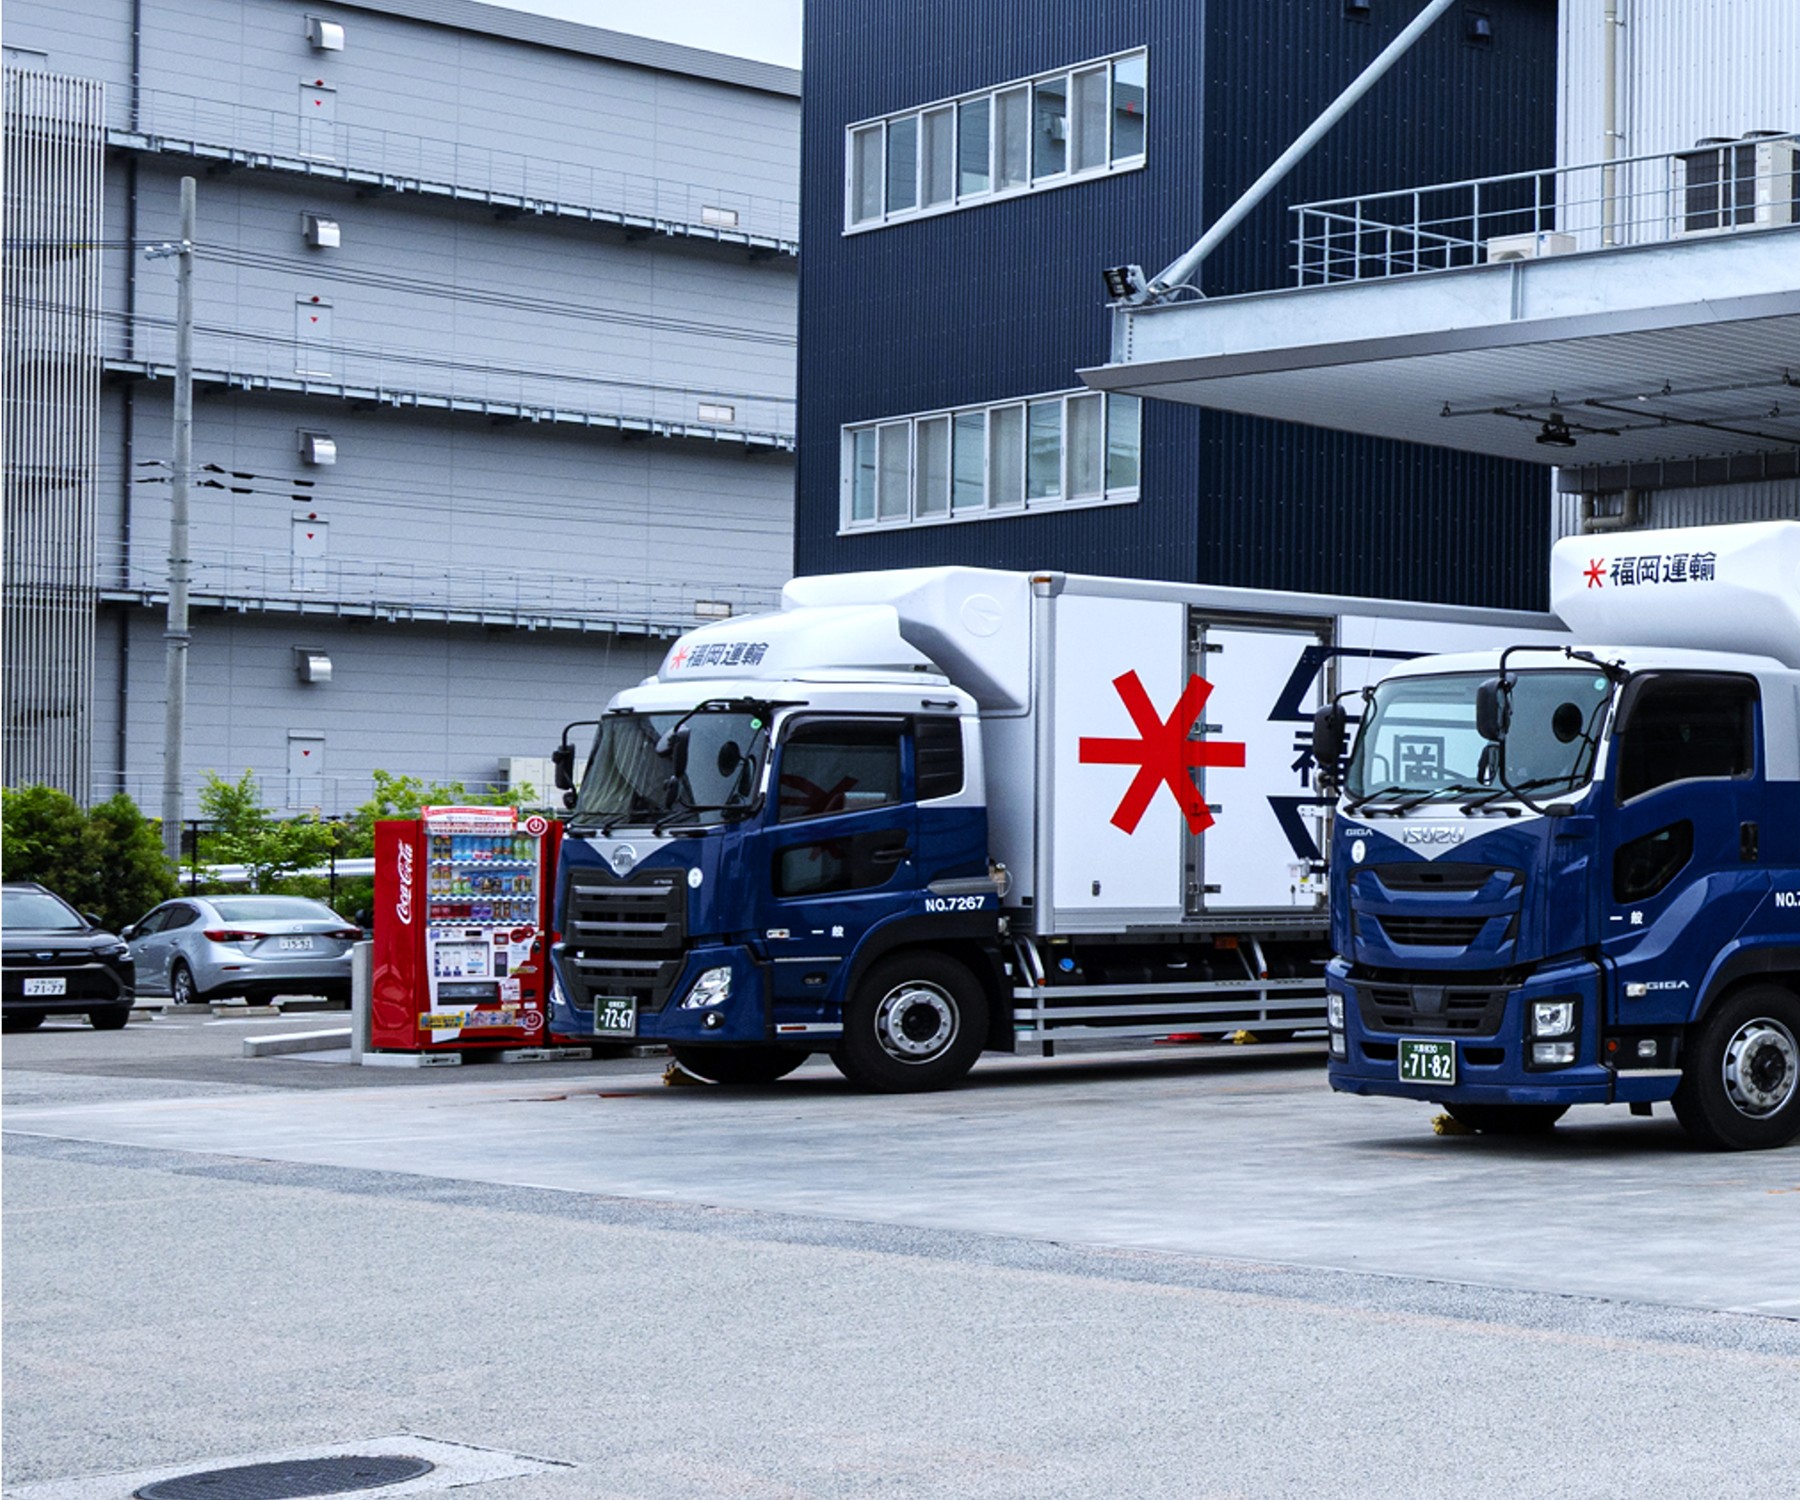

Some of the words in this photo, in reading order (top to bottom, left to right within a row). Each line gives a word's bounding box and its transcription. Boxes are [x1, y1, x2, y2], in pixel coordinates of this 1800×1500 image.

[1610, 551, 1717, 587] 福岡運輸
[686, 642, 769, 668] 福岡運輸
[1345, 828, 1374, 837] GIGA
[1403, 827, 1465, 844] ISUZU
[396, 838, 414, 925] Coca-Cola
[925, 896, 985, 912] NO.7267
[1646, 980, 1690, 990] GIGA
